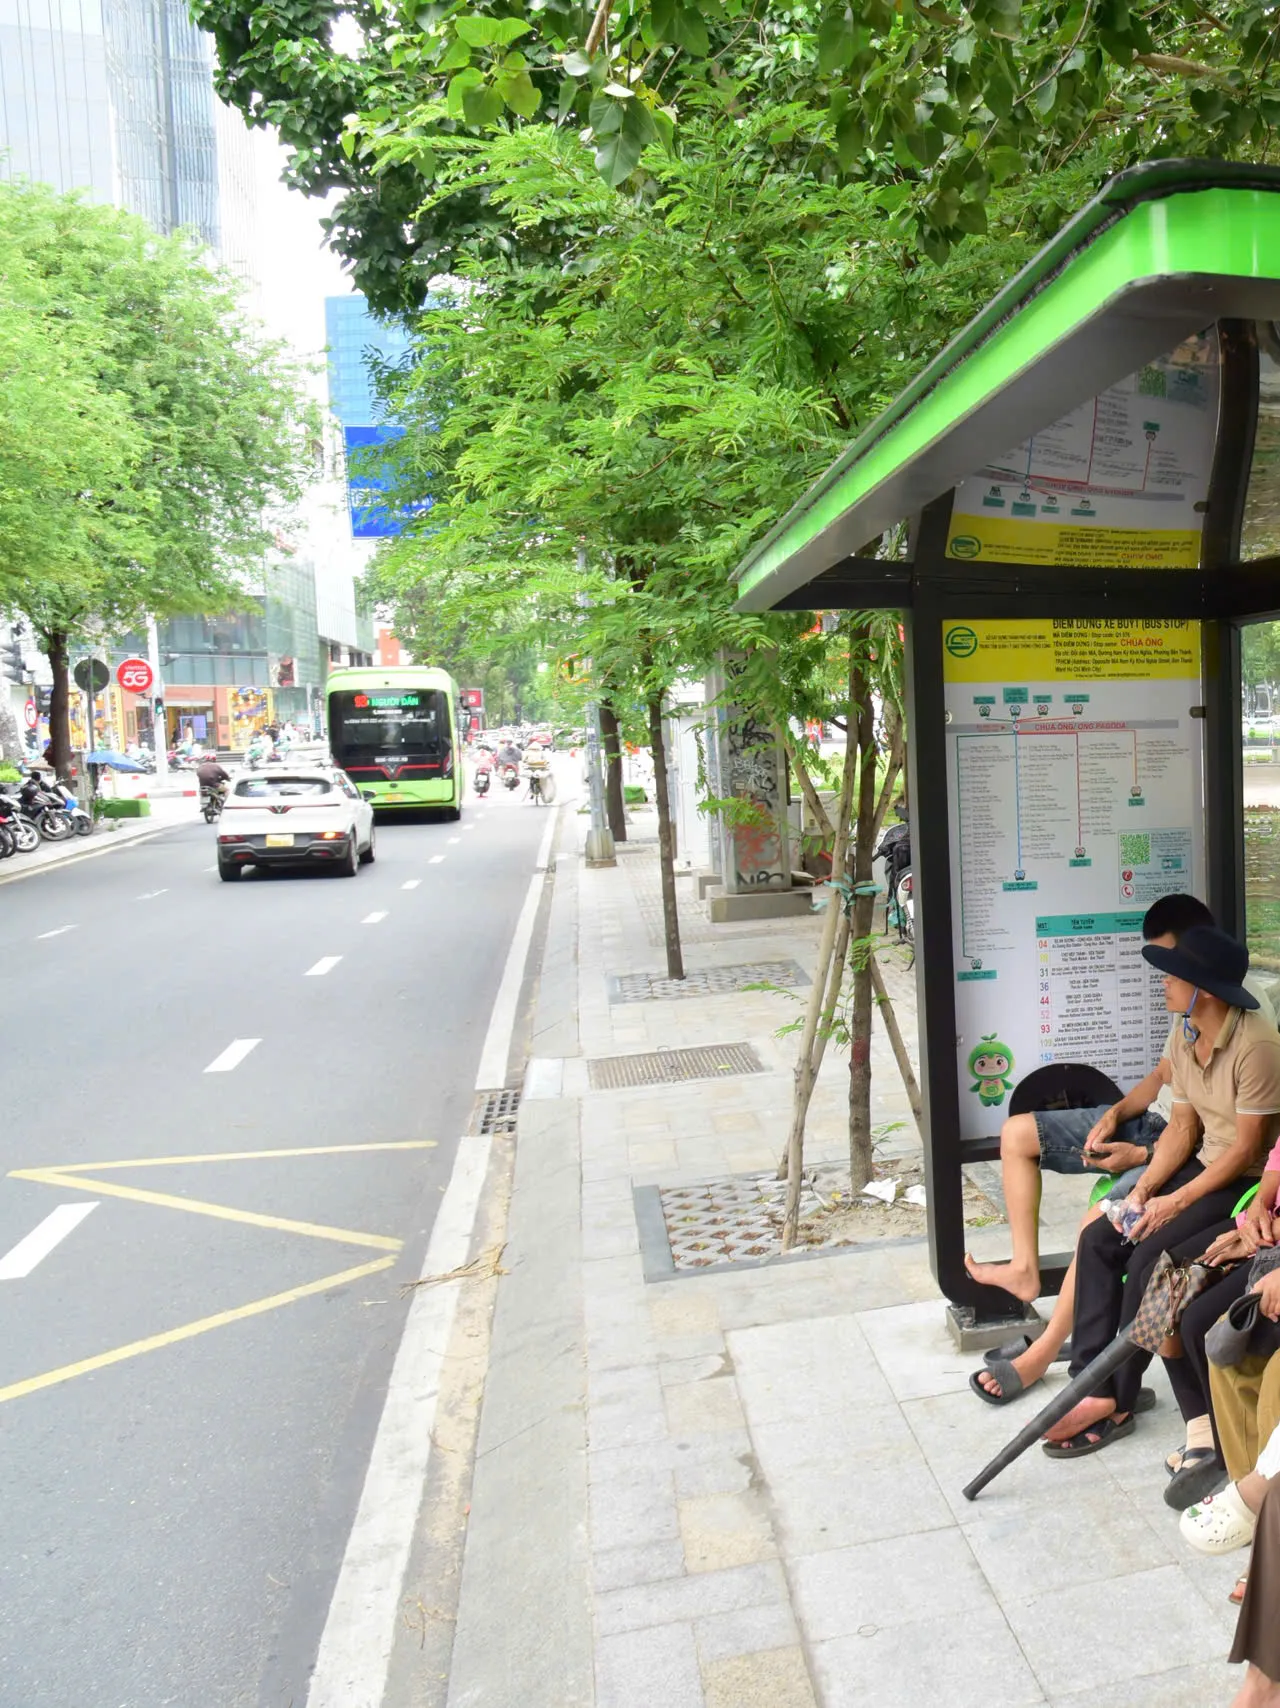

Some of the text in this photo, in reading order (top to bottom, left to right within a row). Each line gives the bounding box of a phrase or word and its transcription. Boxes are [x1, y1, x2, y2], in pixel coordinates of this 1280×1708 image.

[1104, 619, 1114, 629] XE
[123, 671, 148, 686] 5G
[1038, 939, 1048, 949] 04
[1039, 967, 1049, 977] 31
[1039, 981, 1049, 991] 36
[1039, 996, 1050, 1005] 44
[1040, 1024, 1050, 1034] 93
[1040, 1052, 1053, 1062] 152
